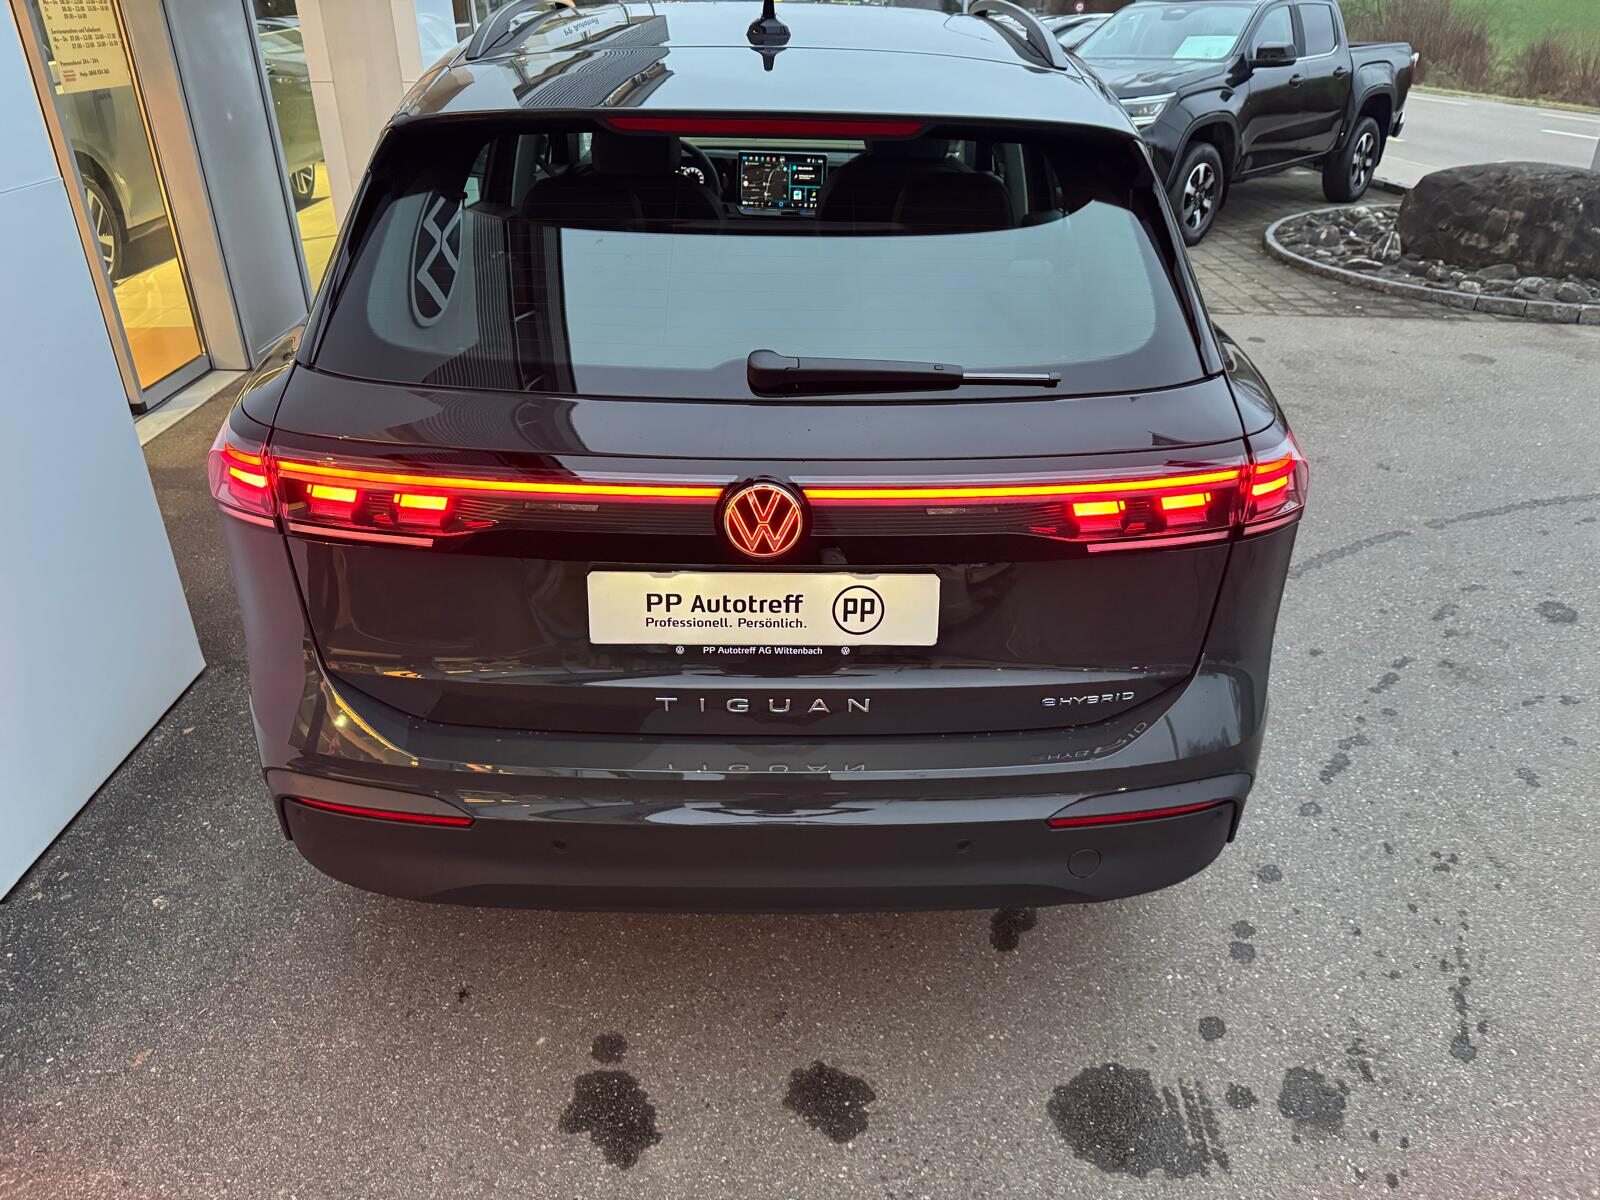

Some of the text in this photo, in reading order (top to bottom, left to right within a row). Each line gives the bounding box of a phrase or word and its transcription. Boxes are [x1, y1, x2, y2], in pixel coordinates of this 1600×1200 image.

[646, 594, 804, 614] PP Autotreff
[842, 598, 875, 622] PP
[646, 617, 807, 628] Professionell. Persönlich.
[718, 646, 756, 654] Autotreff
[758, 646, 772, 654] AG
[774, 646, 822, 655] Wittenbach
[655, 697, 870, 713] TIGUAN
